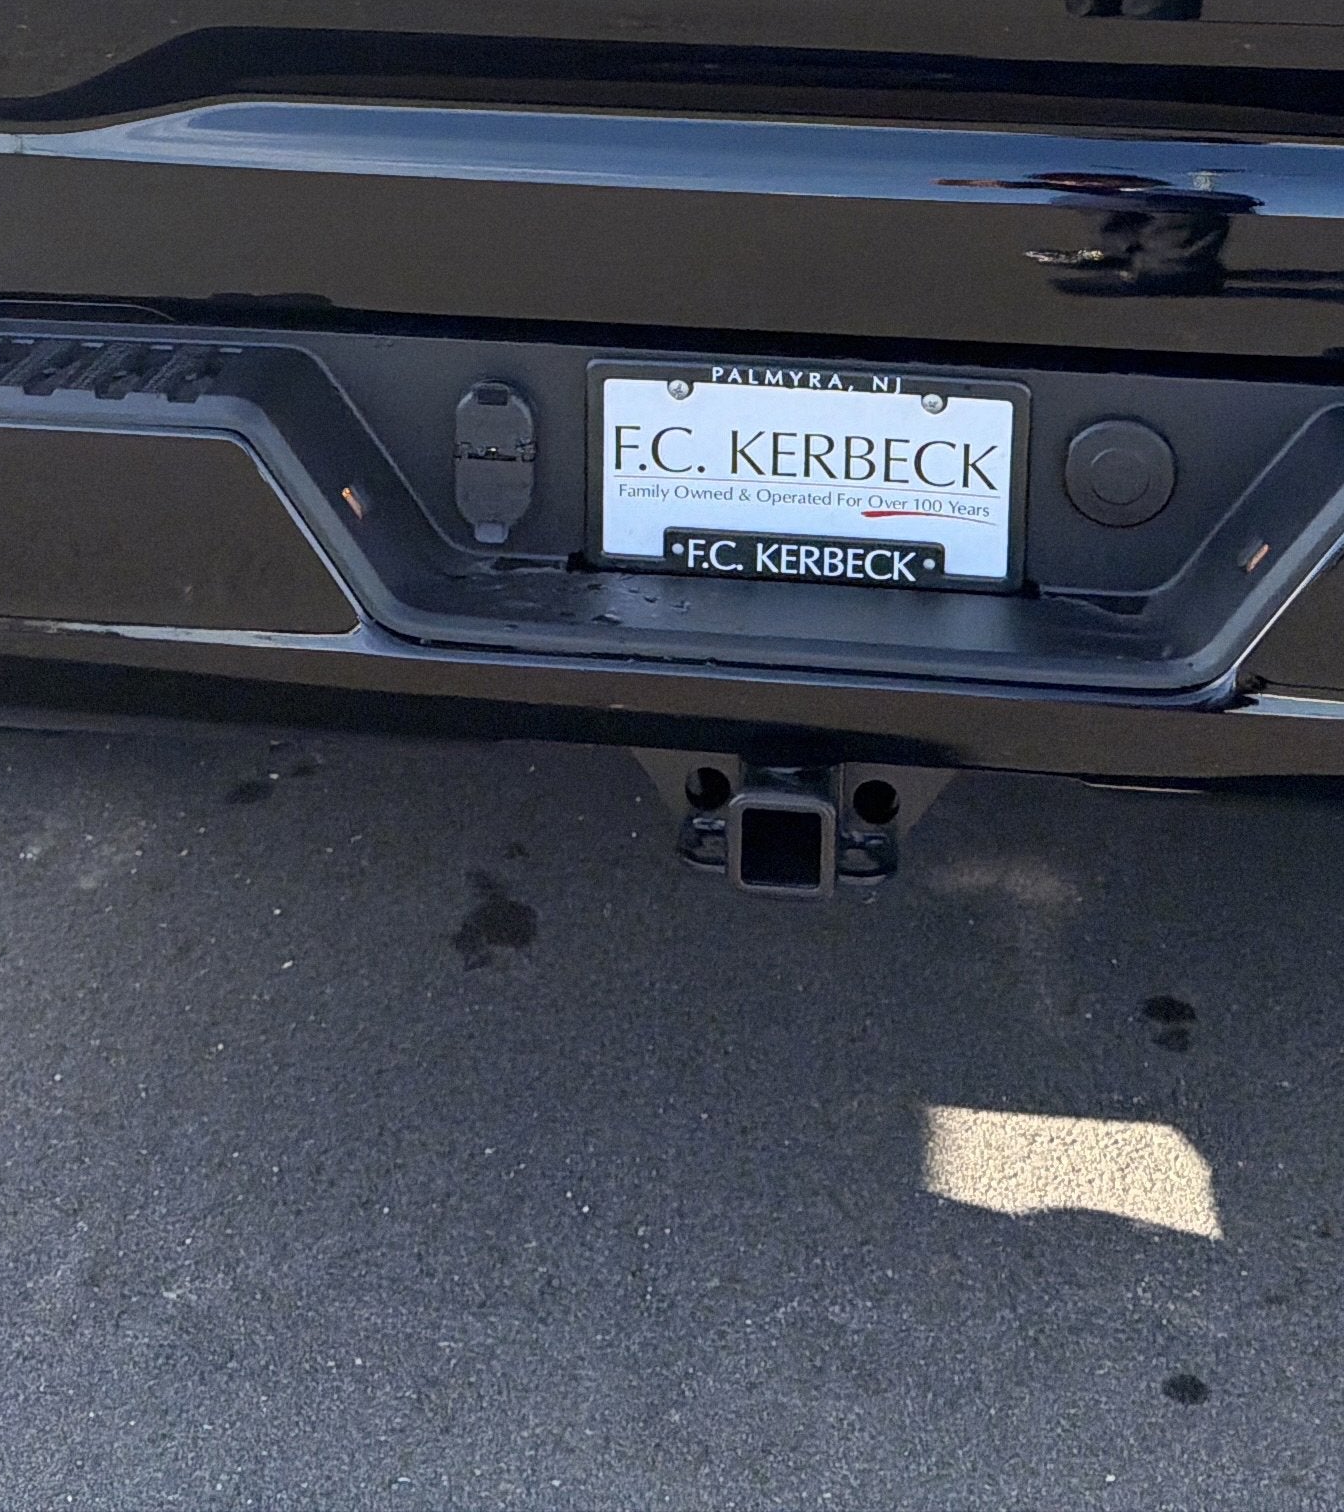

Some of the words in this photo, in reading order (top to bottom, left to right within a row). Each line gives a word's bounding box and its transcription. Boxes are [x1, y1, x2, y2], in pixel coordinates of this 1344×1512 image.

[711, 366, 855, 393] PALMYRA,
[872, 375, 902, 395] NJ
[614, 425, 706, 474] F.C.
[730, 429, 999, 491] KERBECK
[619, 483, 670, 502] Family
[674, 485, 734, 502] Owned
[738, 488, 752, 502] &
[756, 488, 833, 507] Operated
[837, 492, 863, 508] For
[868, 494, 909, 510] Over
[914, 498, 943, 513] 100
[948, 500, 991, 518] Years
[686, 538, 745, 572] F.C.
[756, 542, 917, 583] KERBECK
